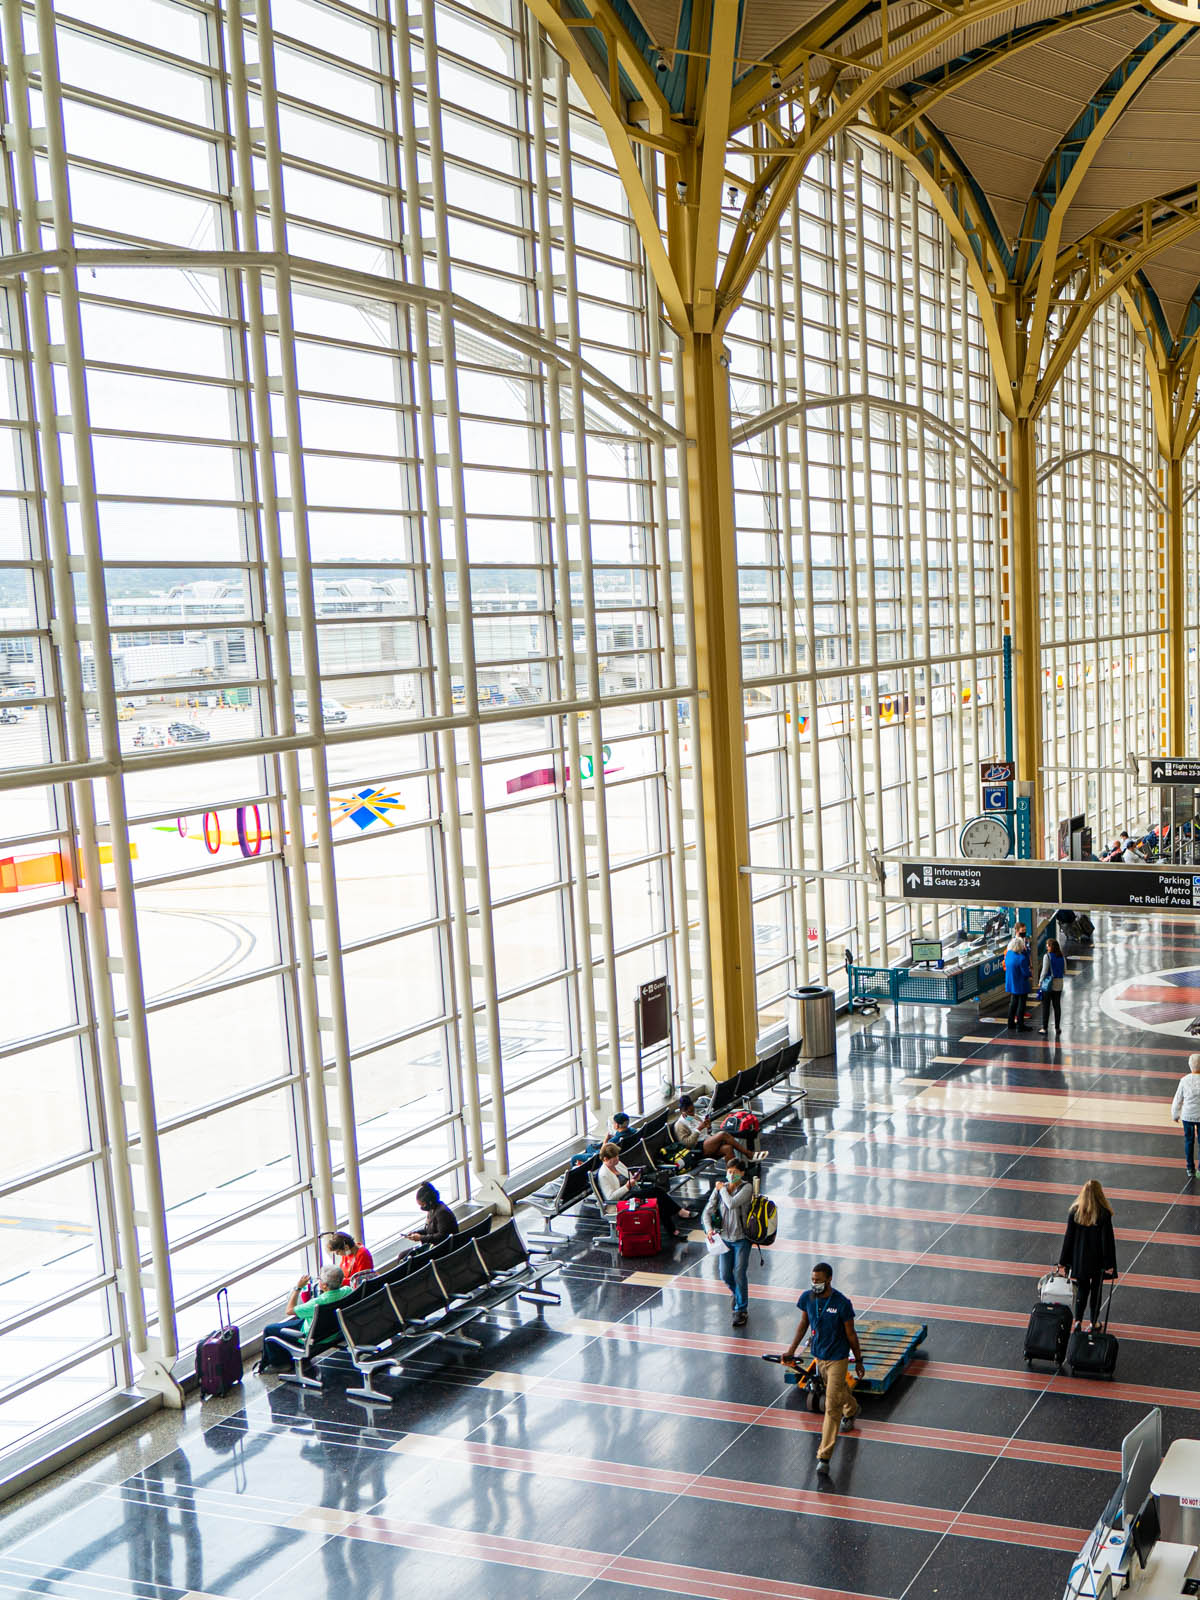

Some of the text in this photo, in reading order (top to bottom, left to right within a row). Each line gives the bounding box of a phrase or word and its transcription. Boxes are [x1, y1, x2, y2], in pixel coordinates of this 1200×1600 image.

[990, 792, 1001, 807] C
[934, 868, 981, 877] Information
[935, 878, 980, 887] Gates 23-34
[1159, 876, 1190, 886] Parking
[1165, 886, 1190, 895] Metro
[1130, 895, 1190, 905] Pet Relief Area
